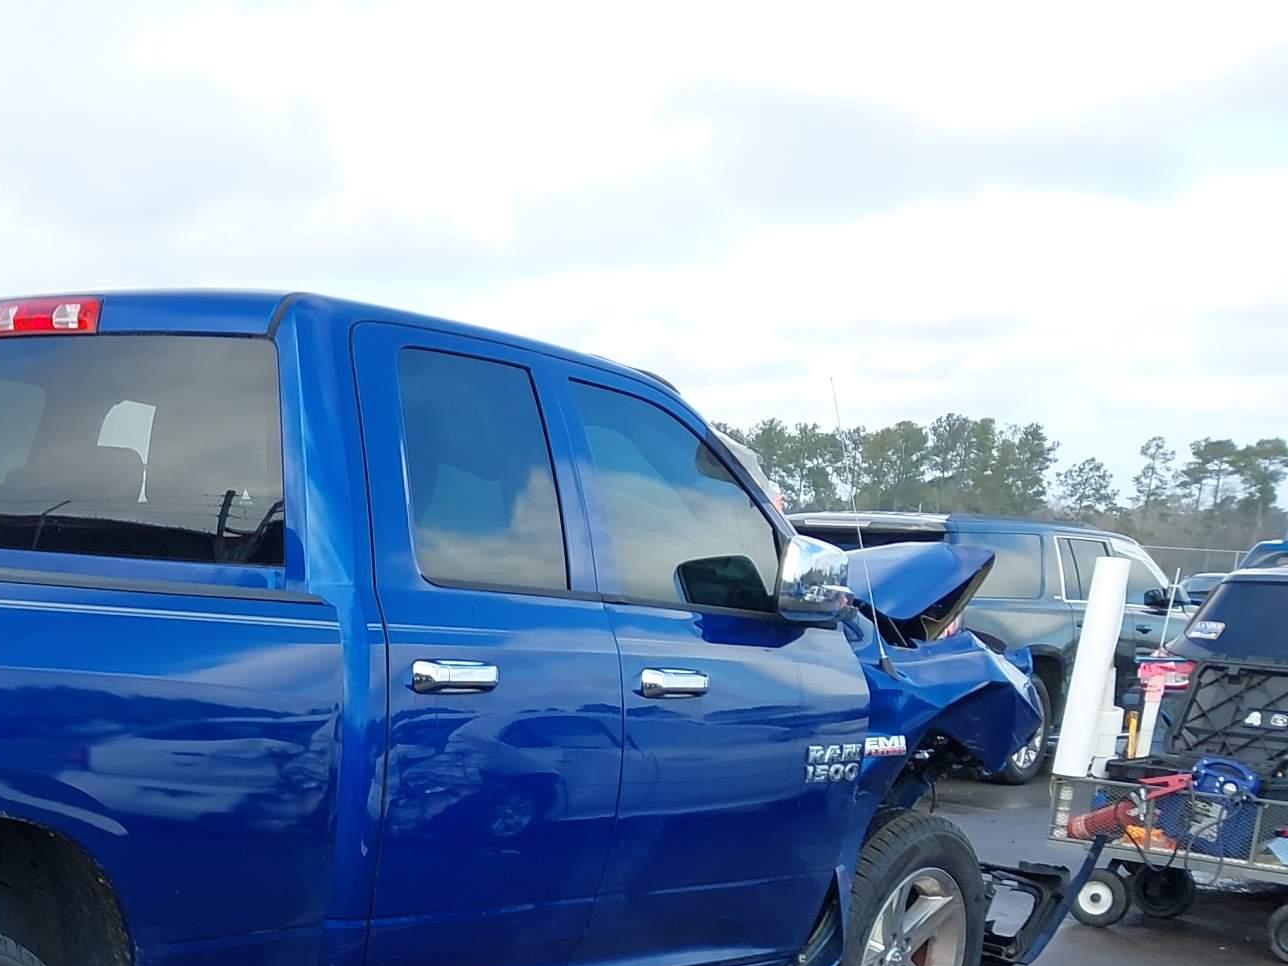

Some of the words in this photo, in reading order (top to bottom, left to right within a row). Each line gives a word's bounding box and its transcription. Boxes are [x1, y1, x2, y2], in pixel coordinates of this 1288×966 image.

[864, 735, 906, 750] EMI
[808, 744, 862, 763] RAM
[805, 763, 860, 783] 1500
